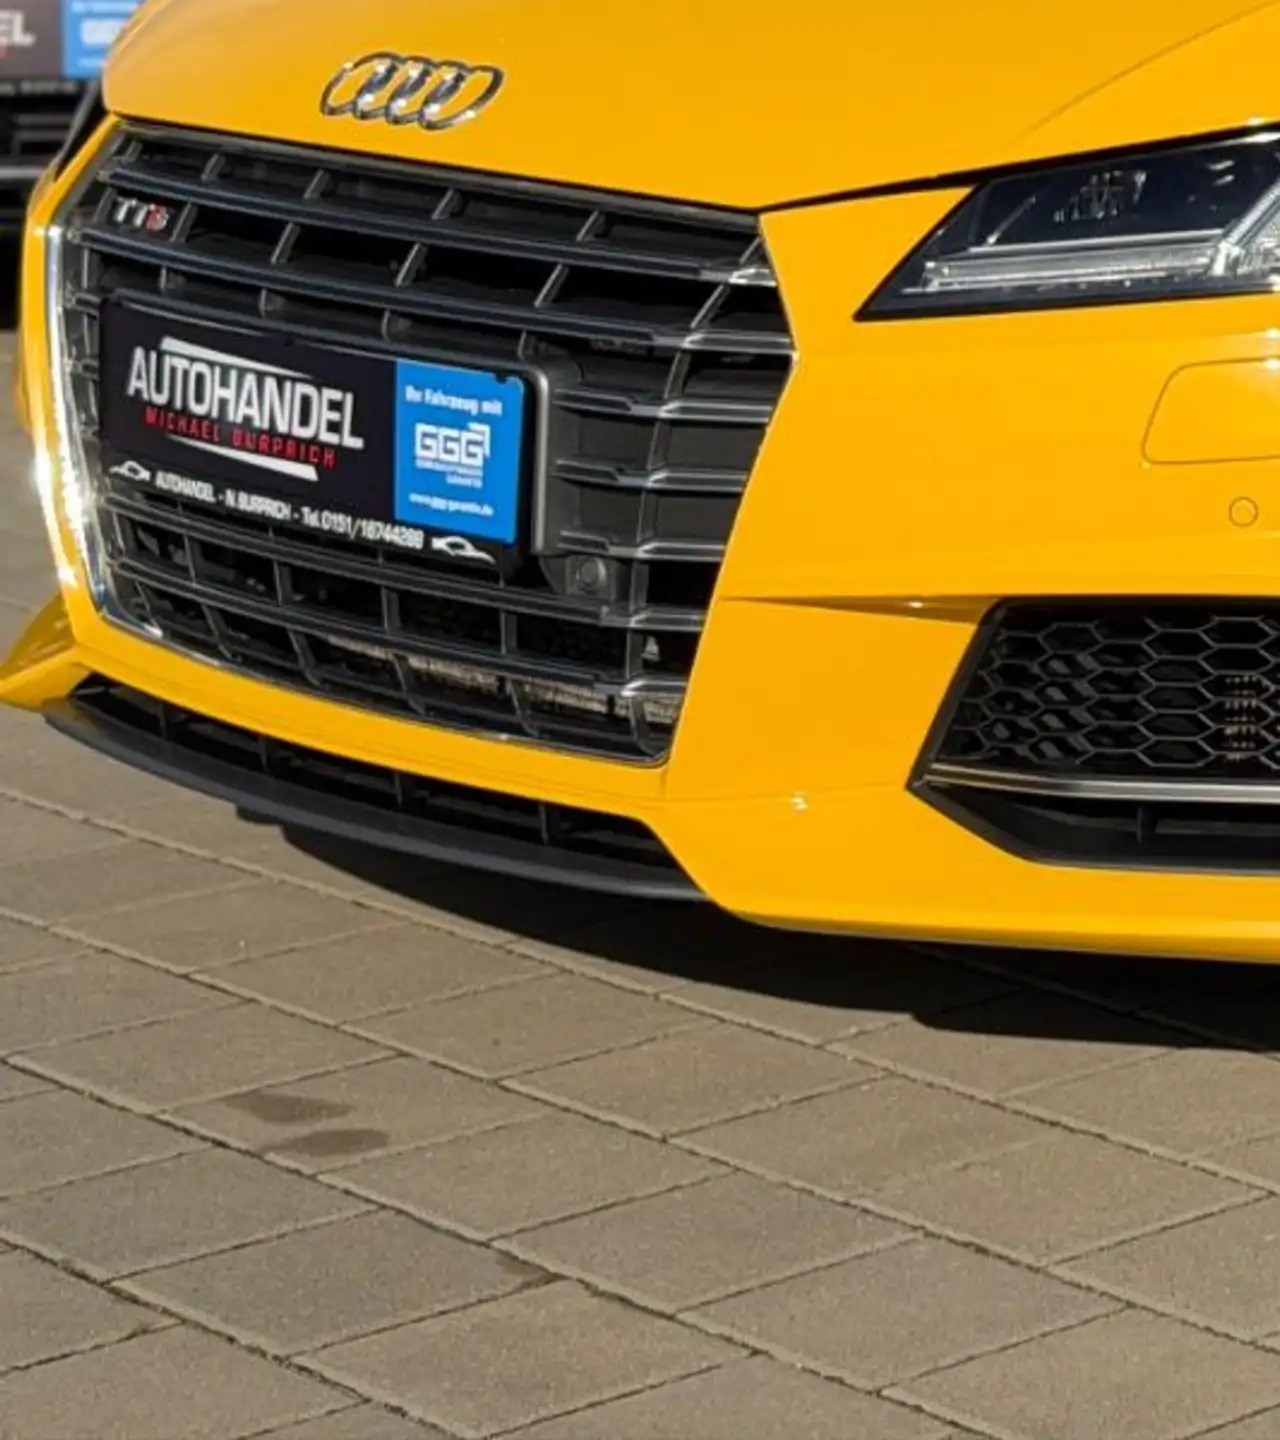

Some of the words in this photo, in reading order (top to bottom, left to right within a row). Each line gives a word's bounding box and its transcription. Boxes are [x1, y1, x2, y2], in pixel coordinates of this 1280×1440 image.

[115, 195, 169, 232] TTS
[127, 346, 364, 450] AUTOHANDEL
[481, 398, 503, 417] mit
[145, 406, 220, 443] MICHAEL
[232, 430, 337, 468] BURPRICH
[415, 422, 486, 467] GGG
[155, 470, 217, 503] AUTOHANDEL
